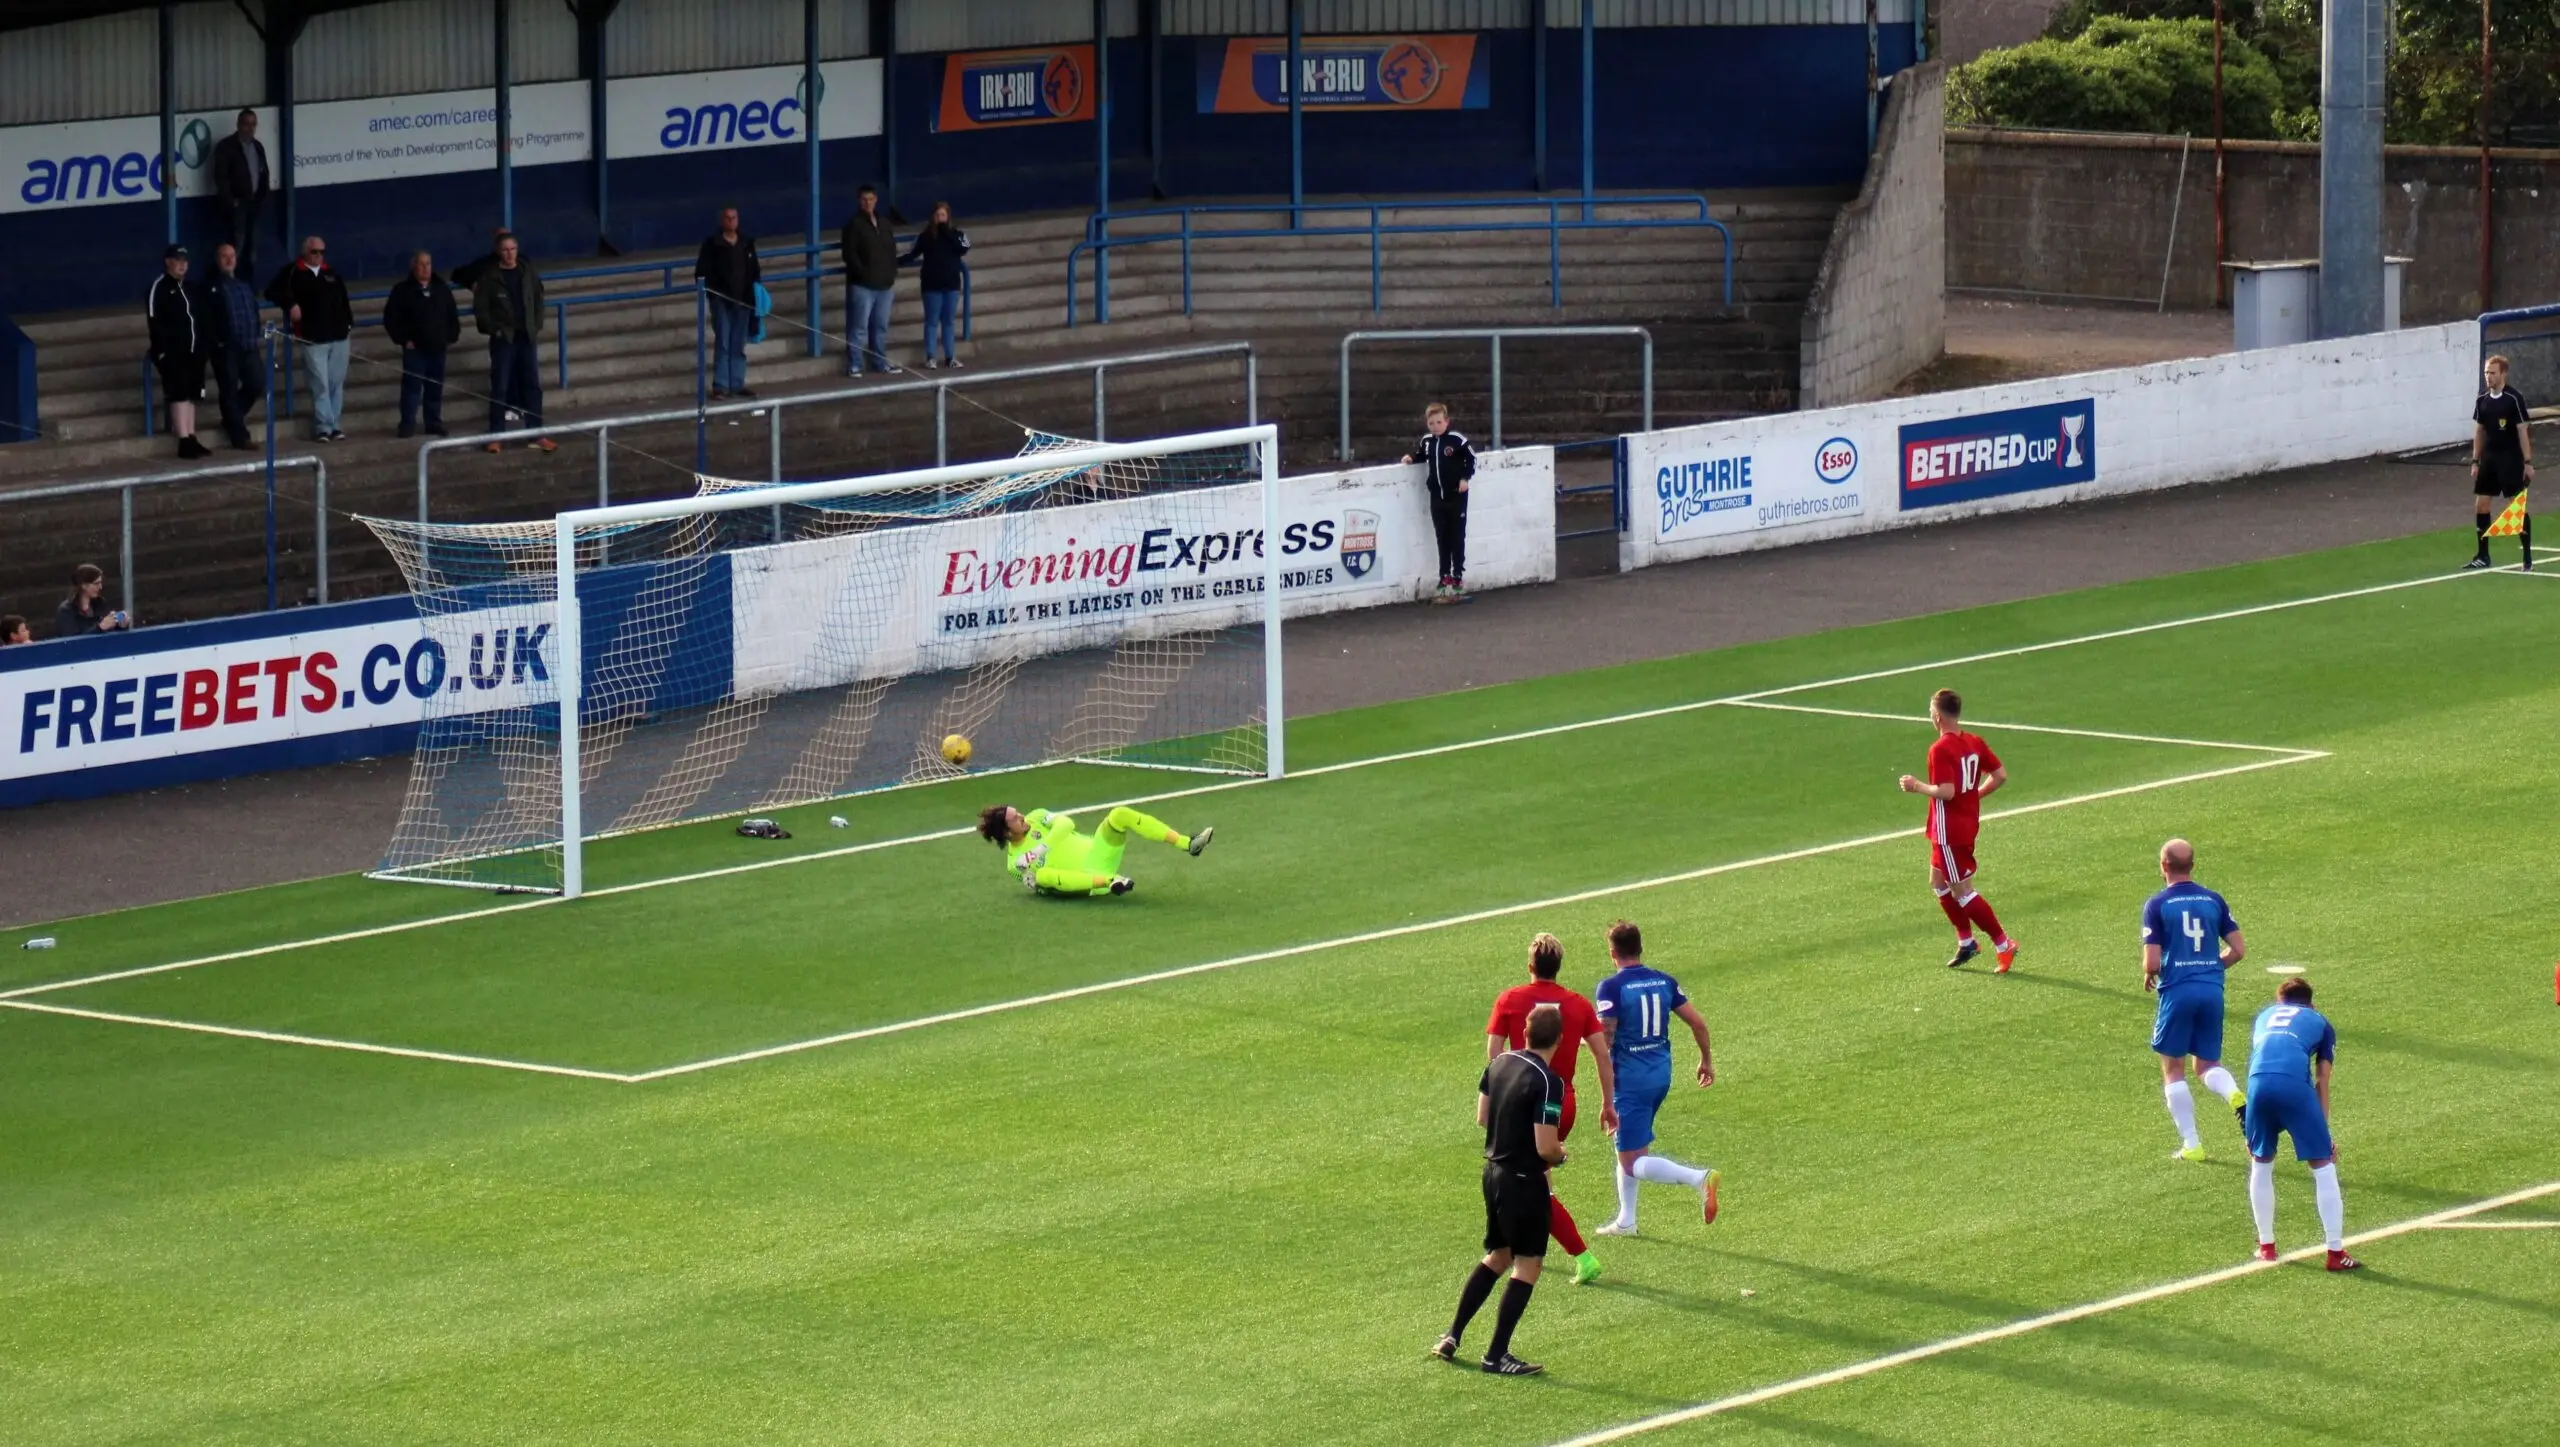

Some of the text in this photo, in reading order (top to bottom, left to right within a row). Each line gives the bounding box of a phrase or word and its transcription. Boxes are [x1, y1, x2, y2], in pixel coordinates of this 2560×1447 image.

[1280, 58, 1365, 93] IN-BRU
[660, 98, 800, 149] amec
[293, 154, 342, 168] Sponsors
[344, 150, 355, 163] of
[356, 148, 372, 161] the
[374, 144, 403, 159] Youth
[406, 139, 473, 158] Development
[526, 131, 585, 147] Programme
[1657, 456, 1752, 500] GUTHRIE
[1911, 433, 2057, 482] BETFRED CUP
[1661, 489, 1704, 535] Bros
[1708, 496, 1747, 512] MONTROSE
[1758, 492, 1859, 526] guthriebros.com
[944, 612, 979, 631] FOR
[986, 608, 1019, 626] ALL
[1026, 602, 1061, 620] THE
[1069, 592, 1134, 615] LATEST
[1141, 589, 1164, 606] ON
[1171, 584, 1205, 602] THE
[1279, 567, 1333, 590] NDEES
[20, 622, 551, 754] FREEBETS.CO.UK
[1961, 753, 1979, 793] 10
[2182, 911, 2204, 952] 4
[1641, 993, 1662, 1038] 11
[2266, 1006, 2300, 1029] 2
